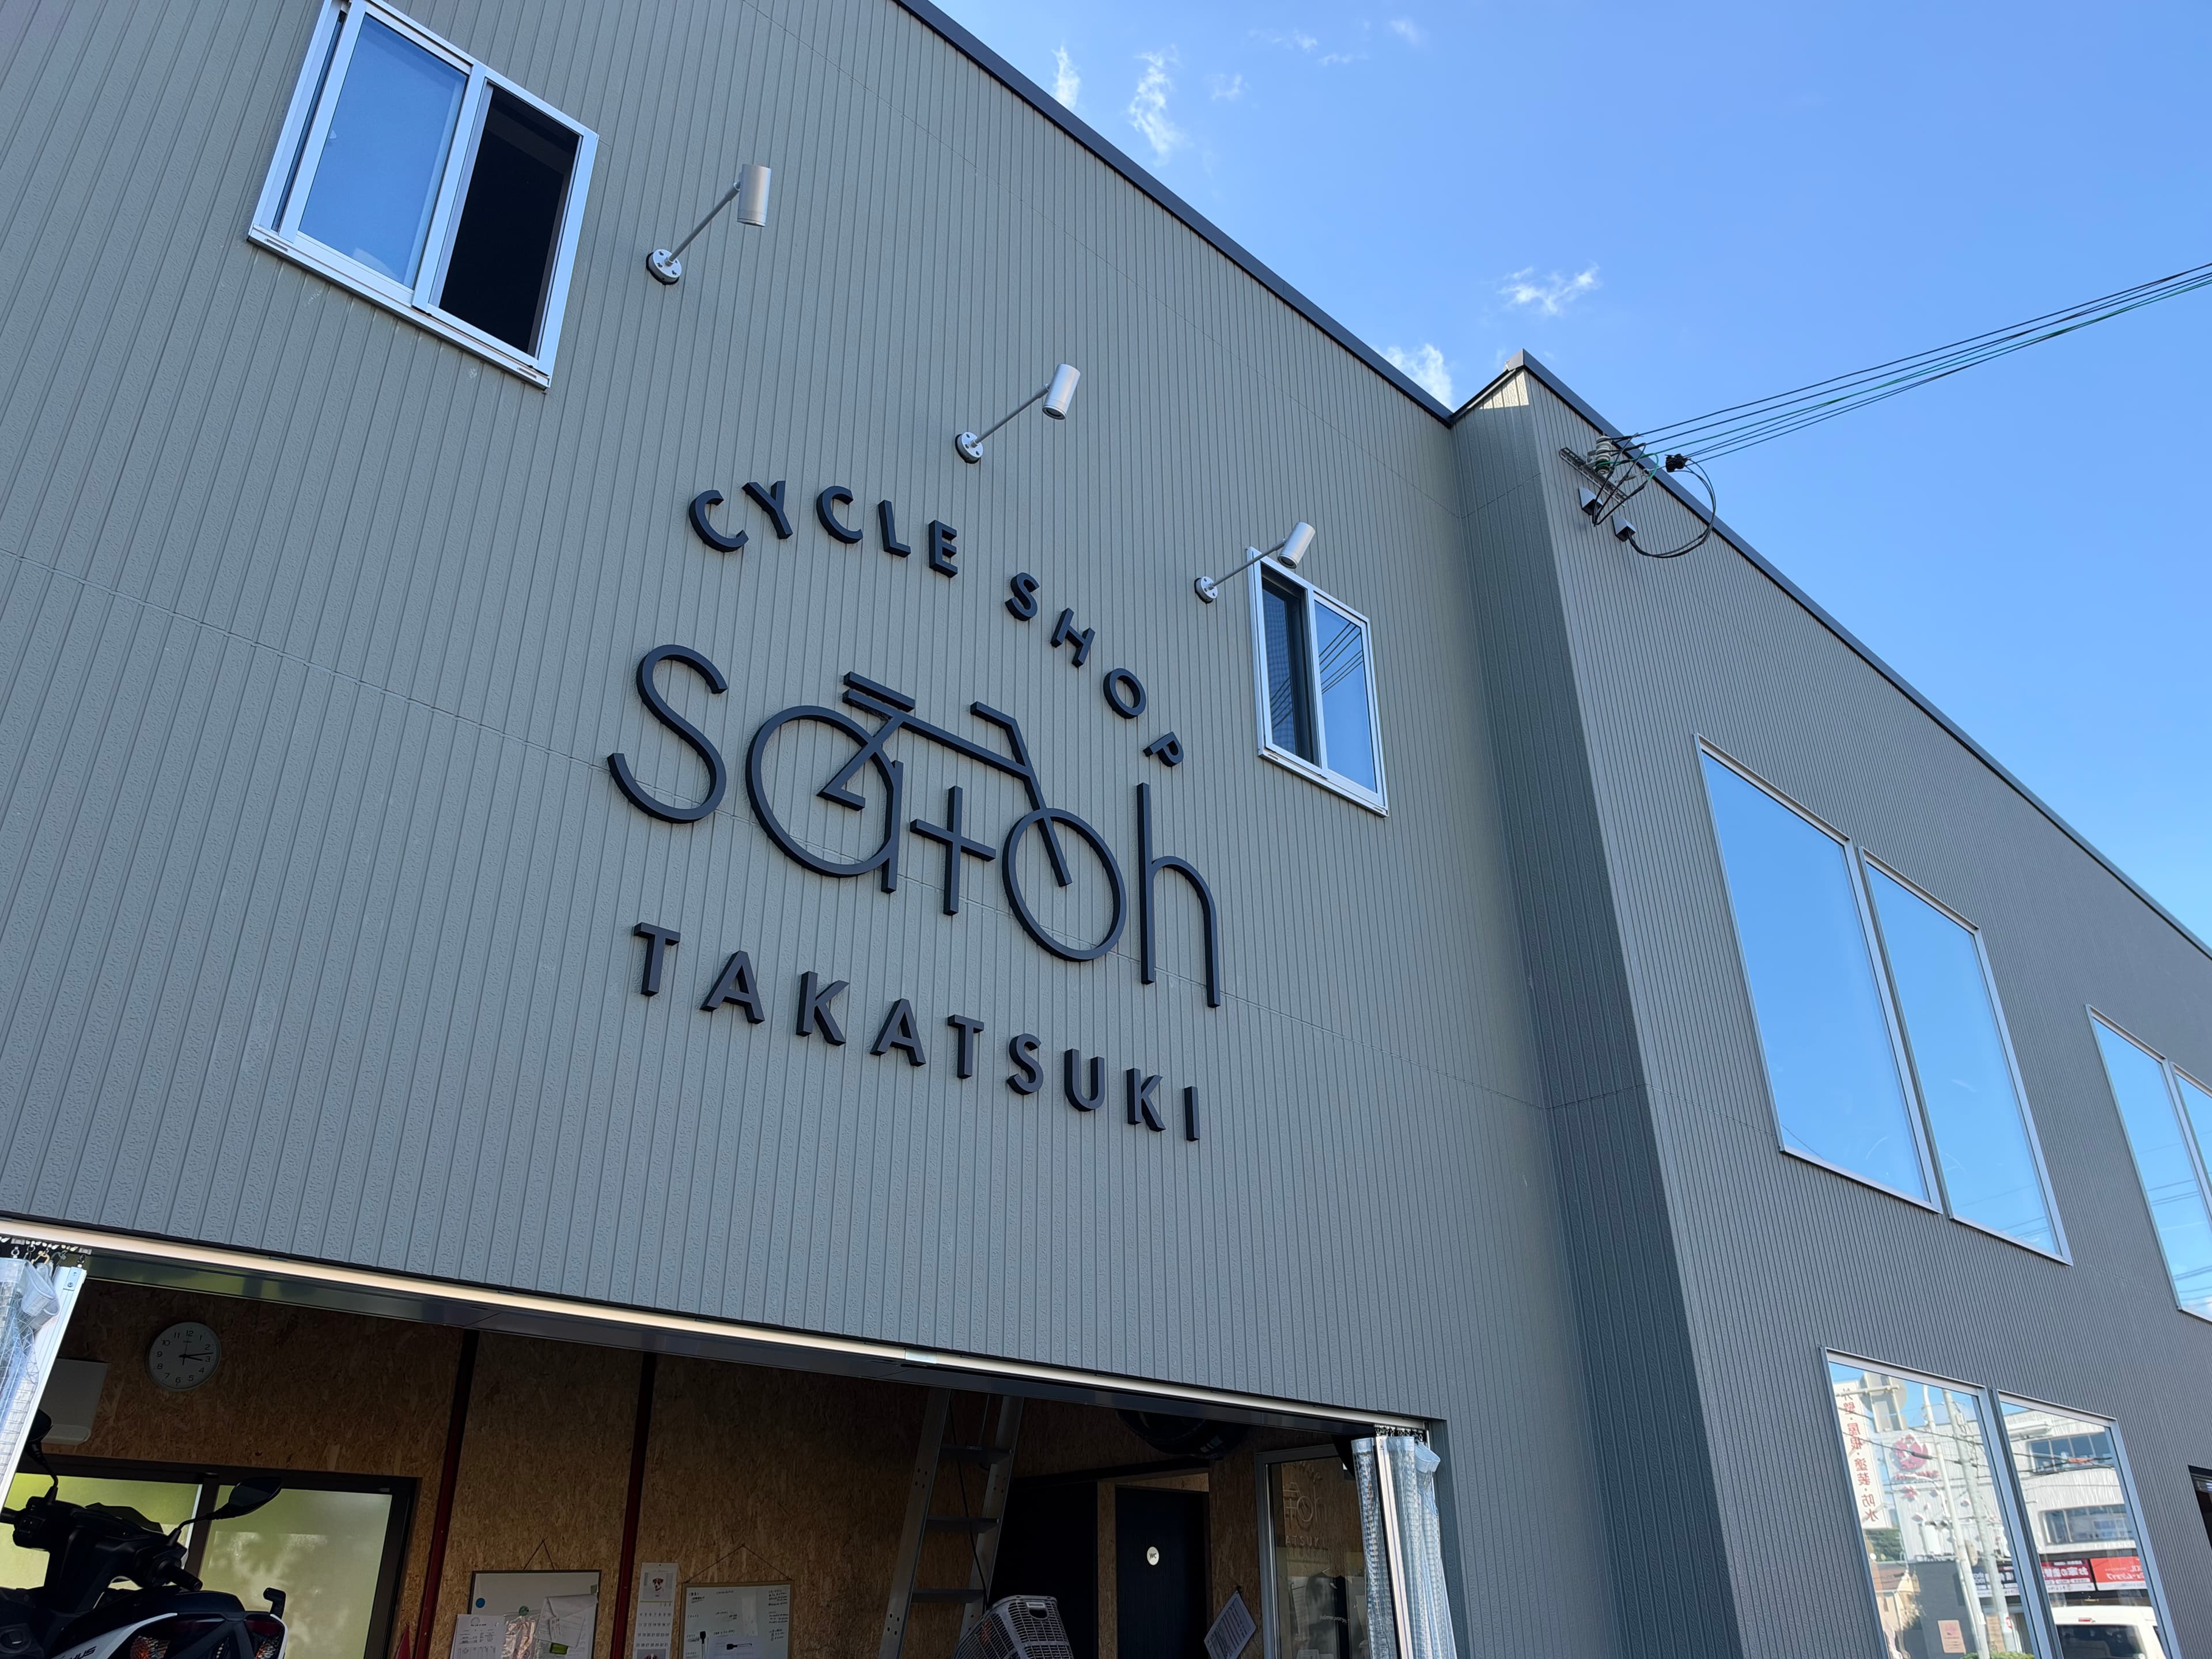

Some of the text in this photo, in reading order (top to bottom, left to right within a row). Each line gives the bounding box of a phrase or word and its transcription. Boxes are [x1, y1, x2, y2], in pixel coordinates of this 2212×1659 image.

[690, 480, 1184, 768] CYCLE SHOP
[607, 645, 1221, 1007] Satoh
[633, 922, 1200, 1141] TAKATSUKI
[1285, 1535, 1326, 1548] ATSUKI
